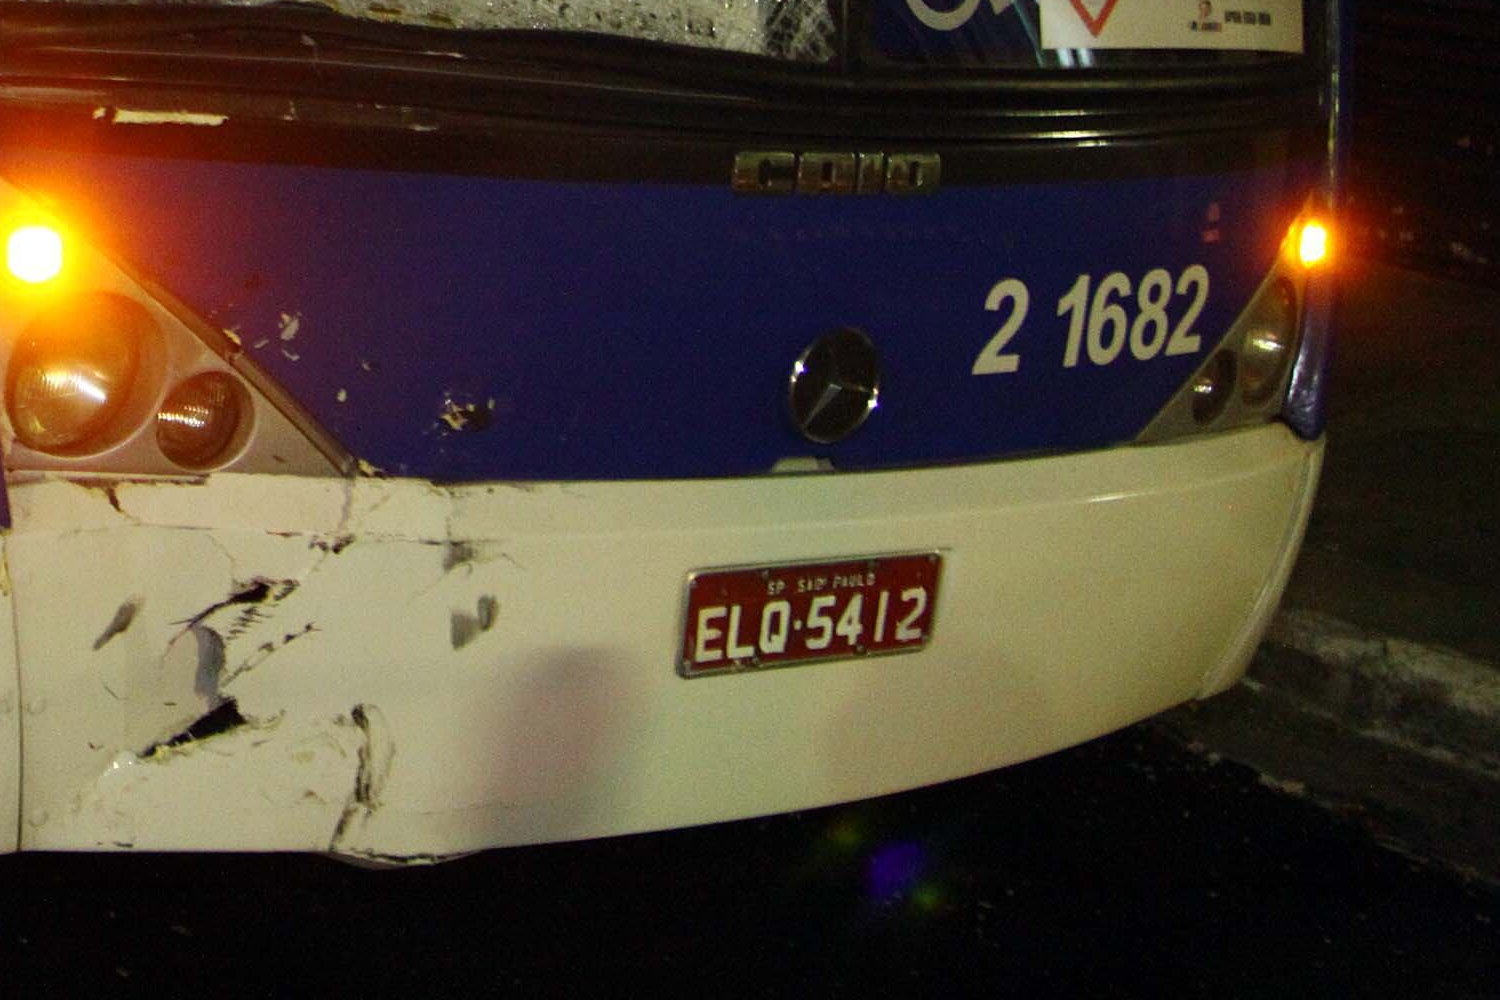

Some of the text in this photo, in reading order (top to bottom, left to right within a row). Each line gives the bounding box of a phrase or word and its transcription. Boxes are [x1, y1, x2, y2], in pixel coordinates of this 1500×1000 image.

[972, 264, 1210, 376] 2 1682
[767, 580, 785, 596] SP
[833, 573, 876, 590] PAULO
